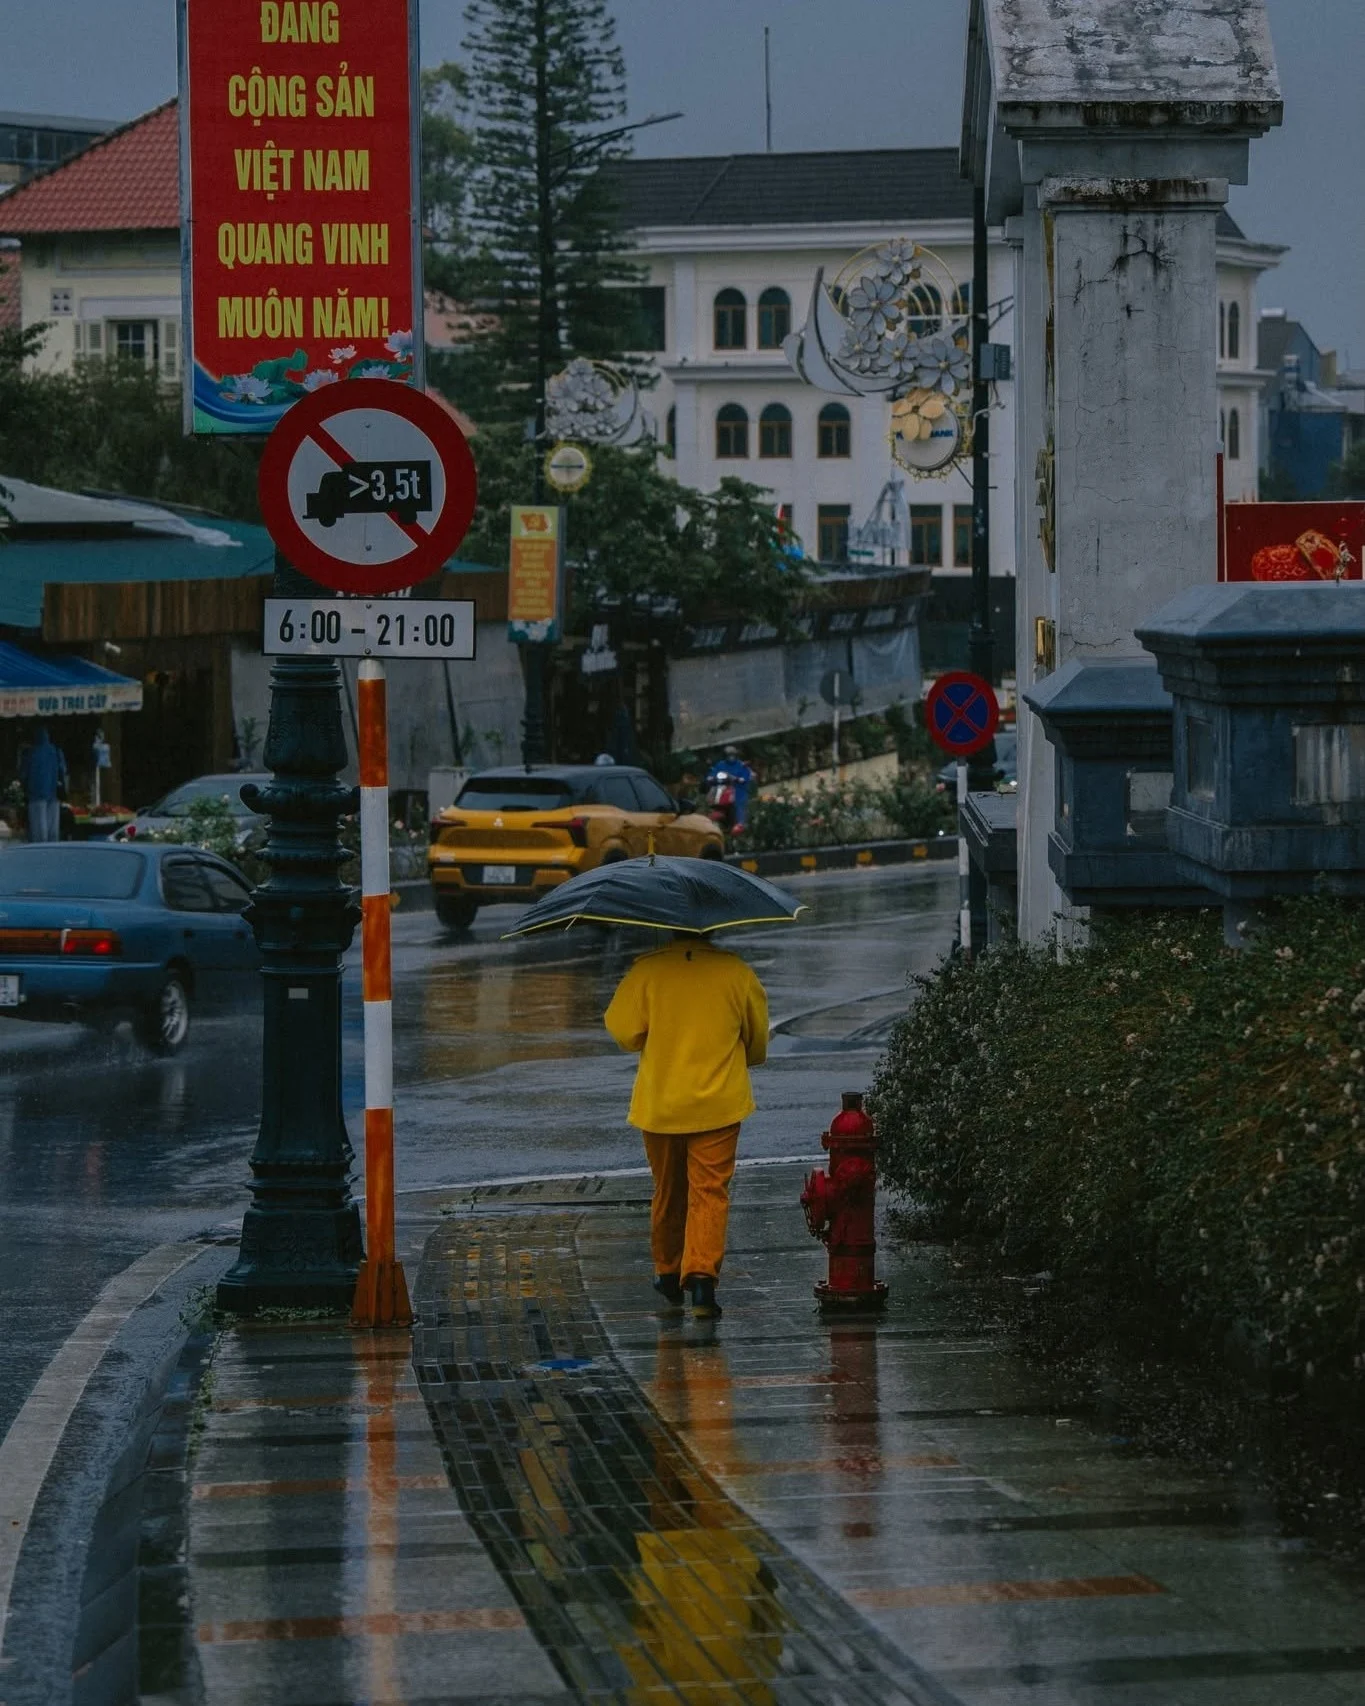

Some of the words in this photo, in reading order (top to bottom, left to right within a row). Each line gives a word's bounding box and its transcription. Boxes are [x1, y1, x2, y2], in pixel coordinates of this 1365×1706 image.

[228, 66, 307, 126] CỘNG
[315, 61, 375, 117] SẢN
[234, 140, 295, 201] VIỆT
[303, 149, 370, 191] NAM
[218, 222, 313, 270] QUANG
[322, 223, 389, 265] VINH
[218, 287, 306, 338] MUÔN
[313, 287, 390, 338] NĂM!
[279, 609, 341, 644] 6:00
[376, 613, 455, 647] 21:00
